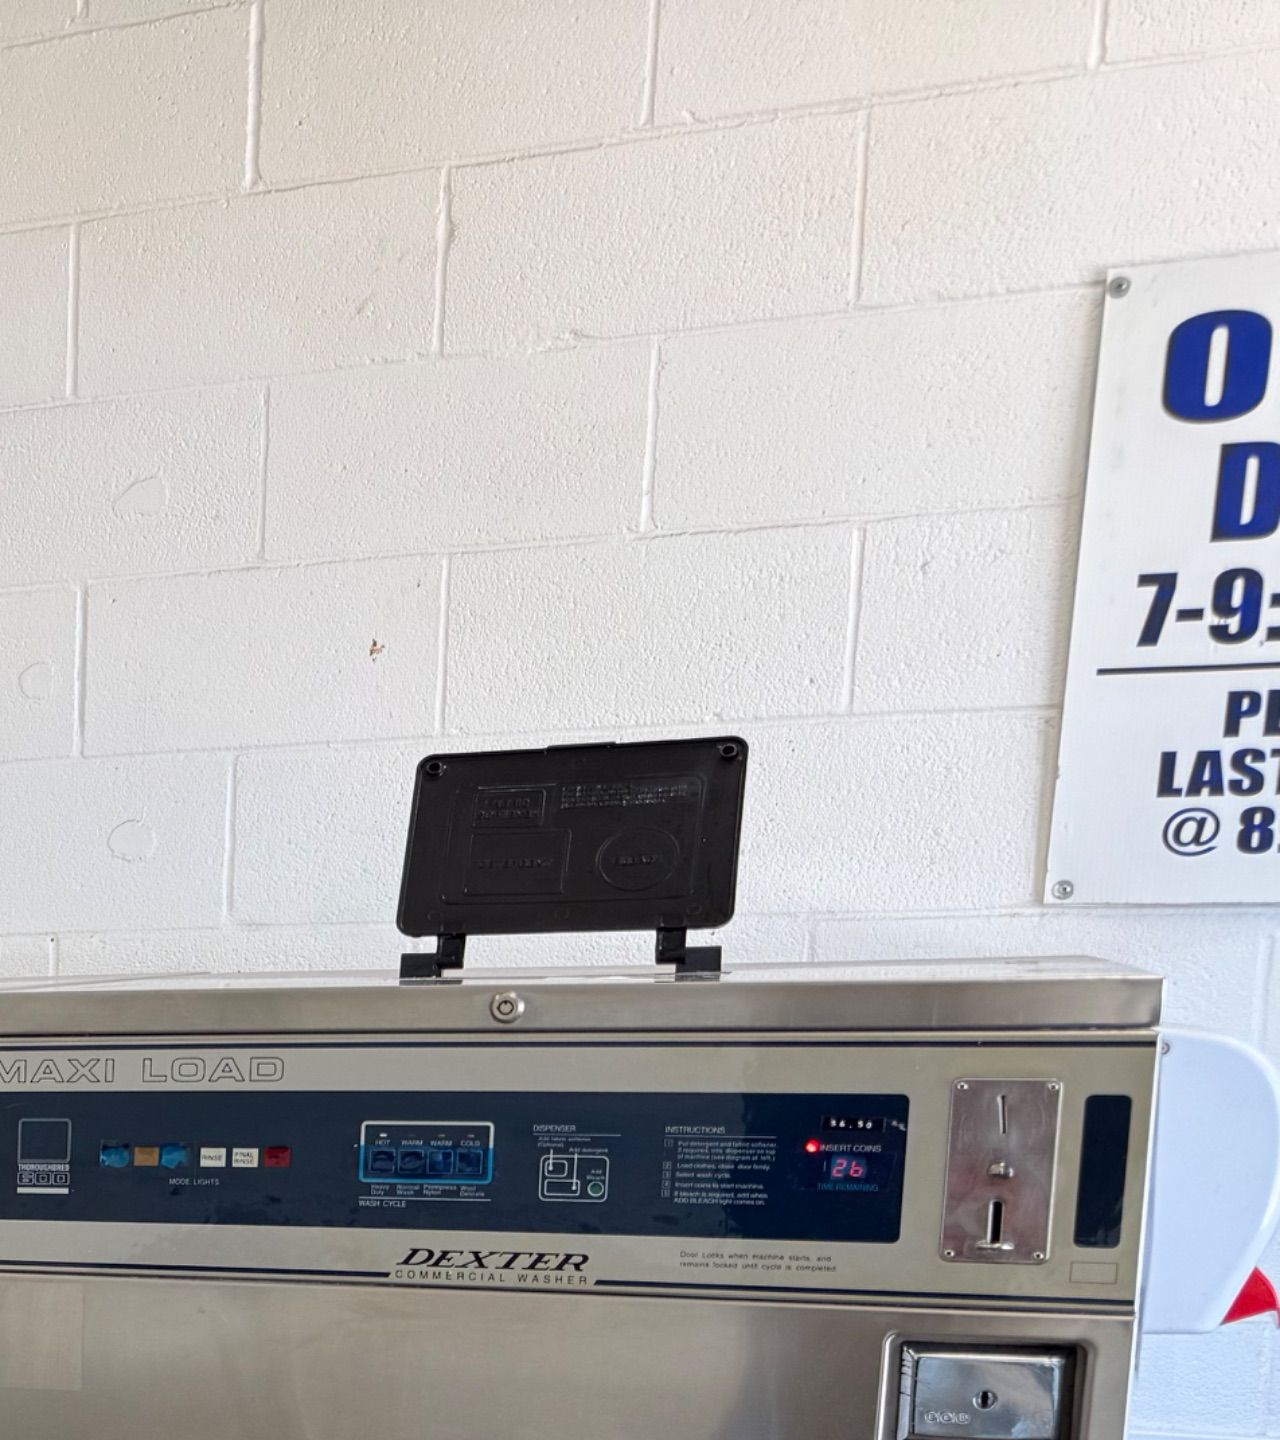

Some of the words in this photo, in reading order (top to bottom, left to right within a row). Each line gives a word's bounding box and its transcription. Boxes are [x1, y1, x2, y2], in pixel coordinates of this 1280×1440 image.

[1162, 807, 1221, 857] @
[142, 1056, 285, 1083] LOAD
[533, 1124, 576, 1132] DISPENSER
[665, 1126, 726, 1134] INSTRUCTIONS
[820, 1143, 851, 1152] INSERT
[853, 1143, 882, 1152] COINS
[832, 1158, 864, 1177] 26
[168, 1178, 190, 1186] MODE
[193, 1178, 220, 1186] LIGHTS
[359, 1200, 380, 1208] WASH
[396, 1248, 589, 1272] DEXTER
[680, 1250, 699, 1258] Door
[728, 1252, 749, 1260] when
[752, 1253, 785, 1261] machine
[713, 1261, 738, 1269] locked
[742, 1262, 758, 1270] until
[761, 1263, 782, 1271] cycle
[395, 1270, 505, 1282] COMMERCIAL
[518, 1273, 588, 1285] WASHER
